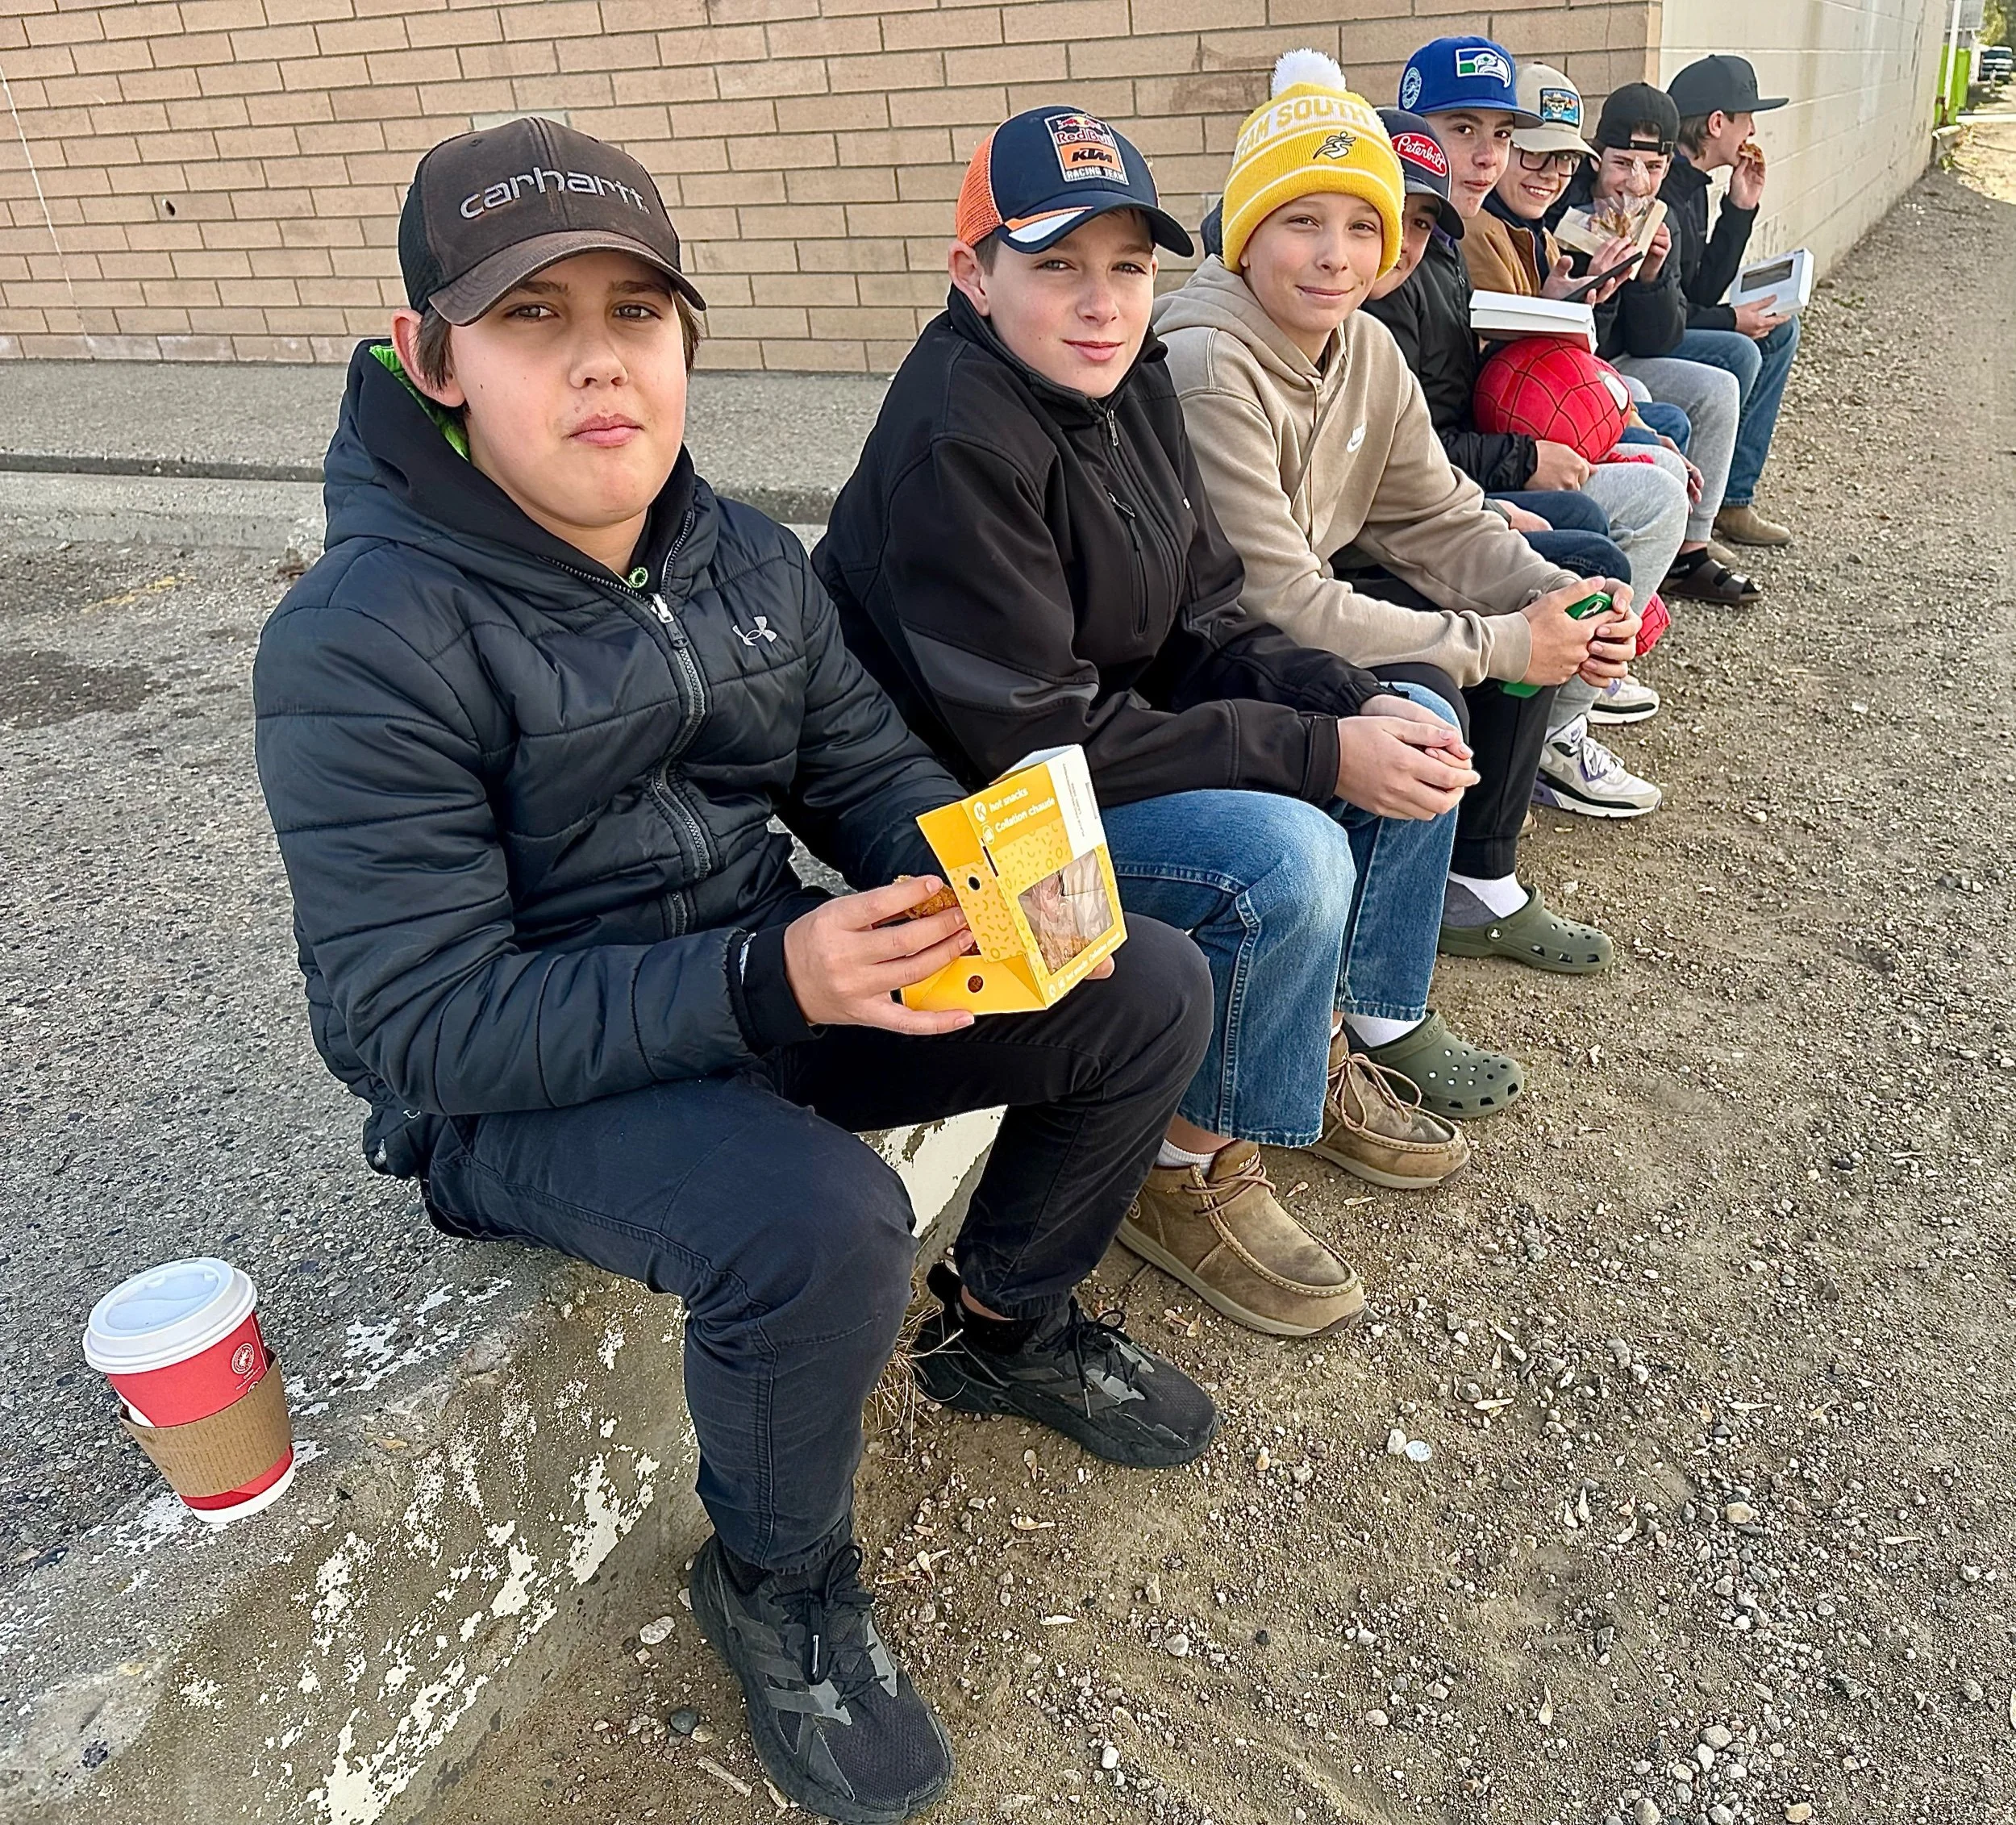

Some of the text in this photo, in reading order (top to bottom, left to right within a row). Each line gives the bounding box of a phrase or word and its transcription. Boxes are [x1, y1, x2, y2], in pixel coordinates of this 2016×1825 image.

[1277, 98, 1369, 127] SOUTH
[1055, 128, 1085, 144] Red
[1072, 148, 1112, 163] KTM
[1397, 135, 1446, 171] Peterbilt
[1066, 167, 1125, 181] RACING TEAM
[460, 167, 646, 219] carhartt
[989, 799, 1003, 813] hot
[1003, 788, 1029, 806] snacks
[995, 810, 1028, 833] Collation
